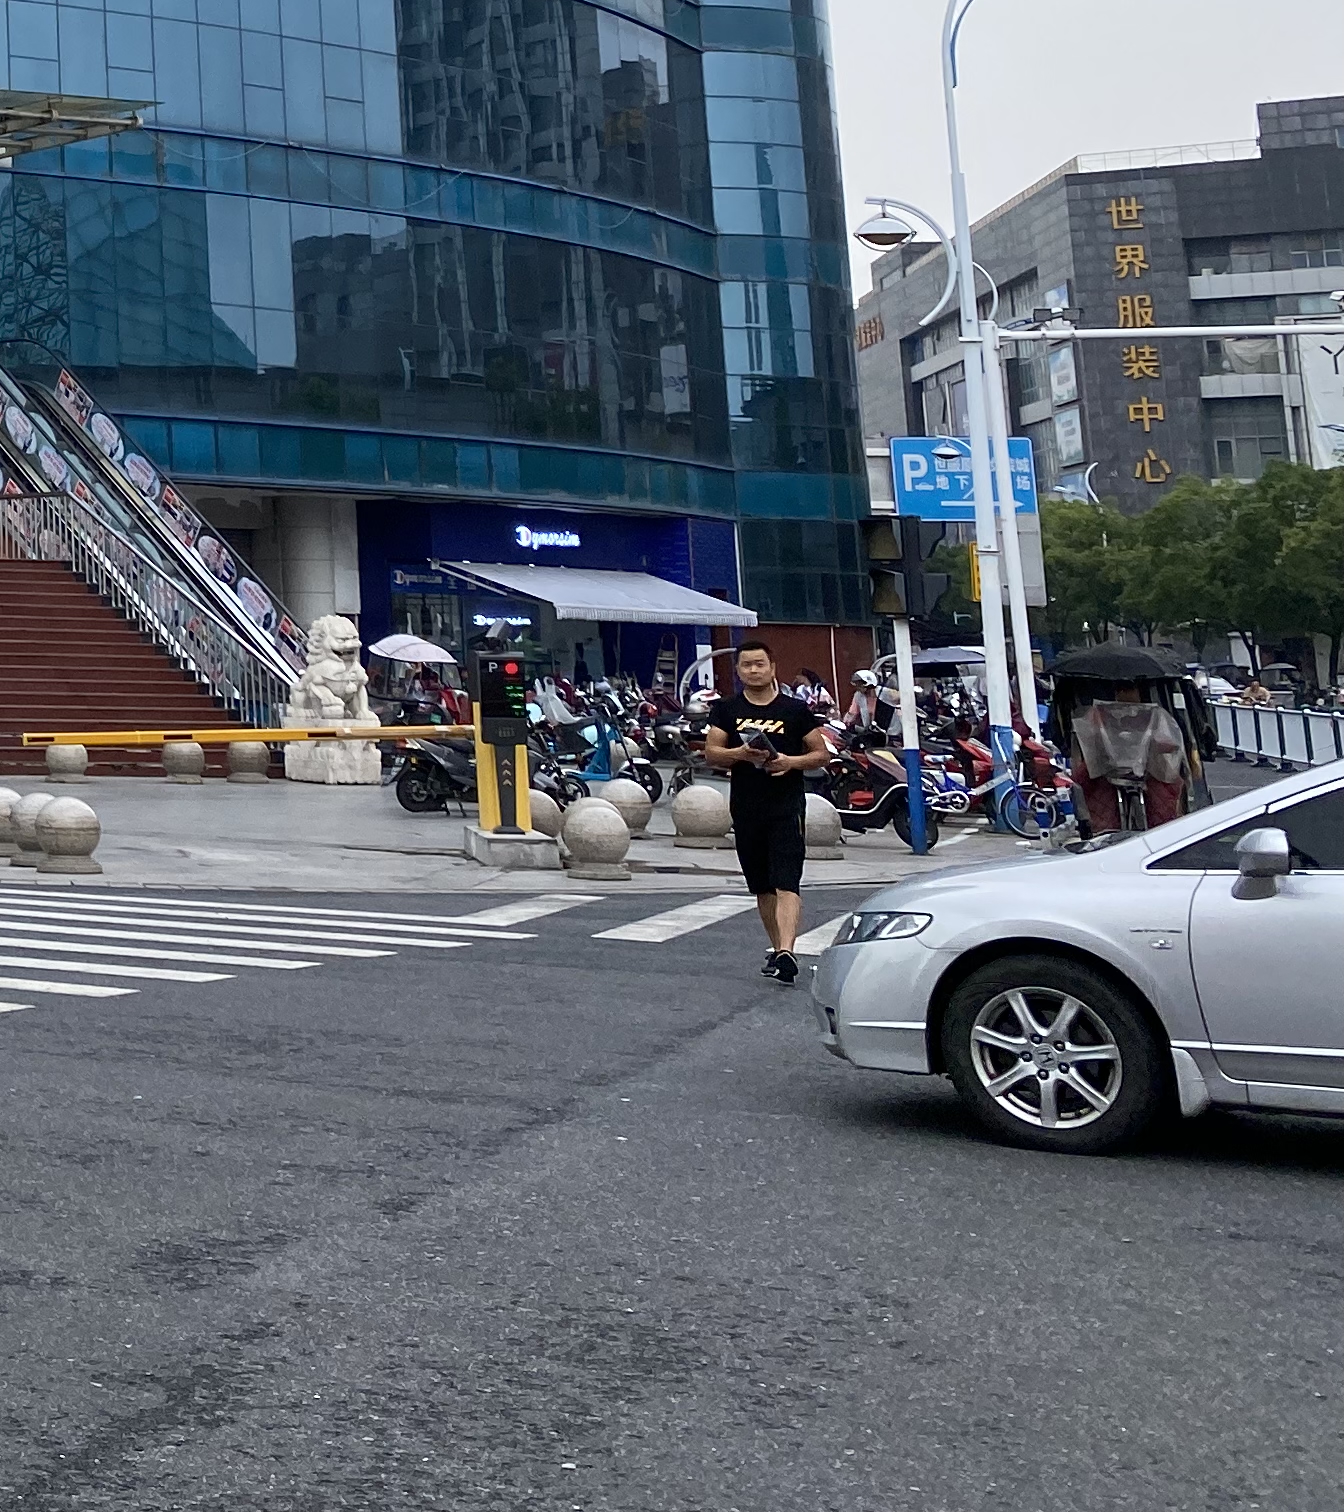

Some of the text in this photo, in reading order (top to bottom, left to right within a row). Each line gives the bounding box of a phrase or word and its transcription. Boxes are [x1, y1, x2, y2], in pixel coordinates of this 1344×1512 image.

[1105, 196, 1172, 485] 世界服装中心
